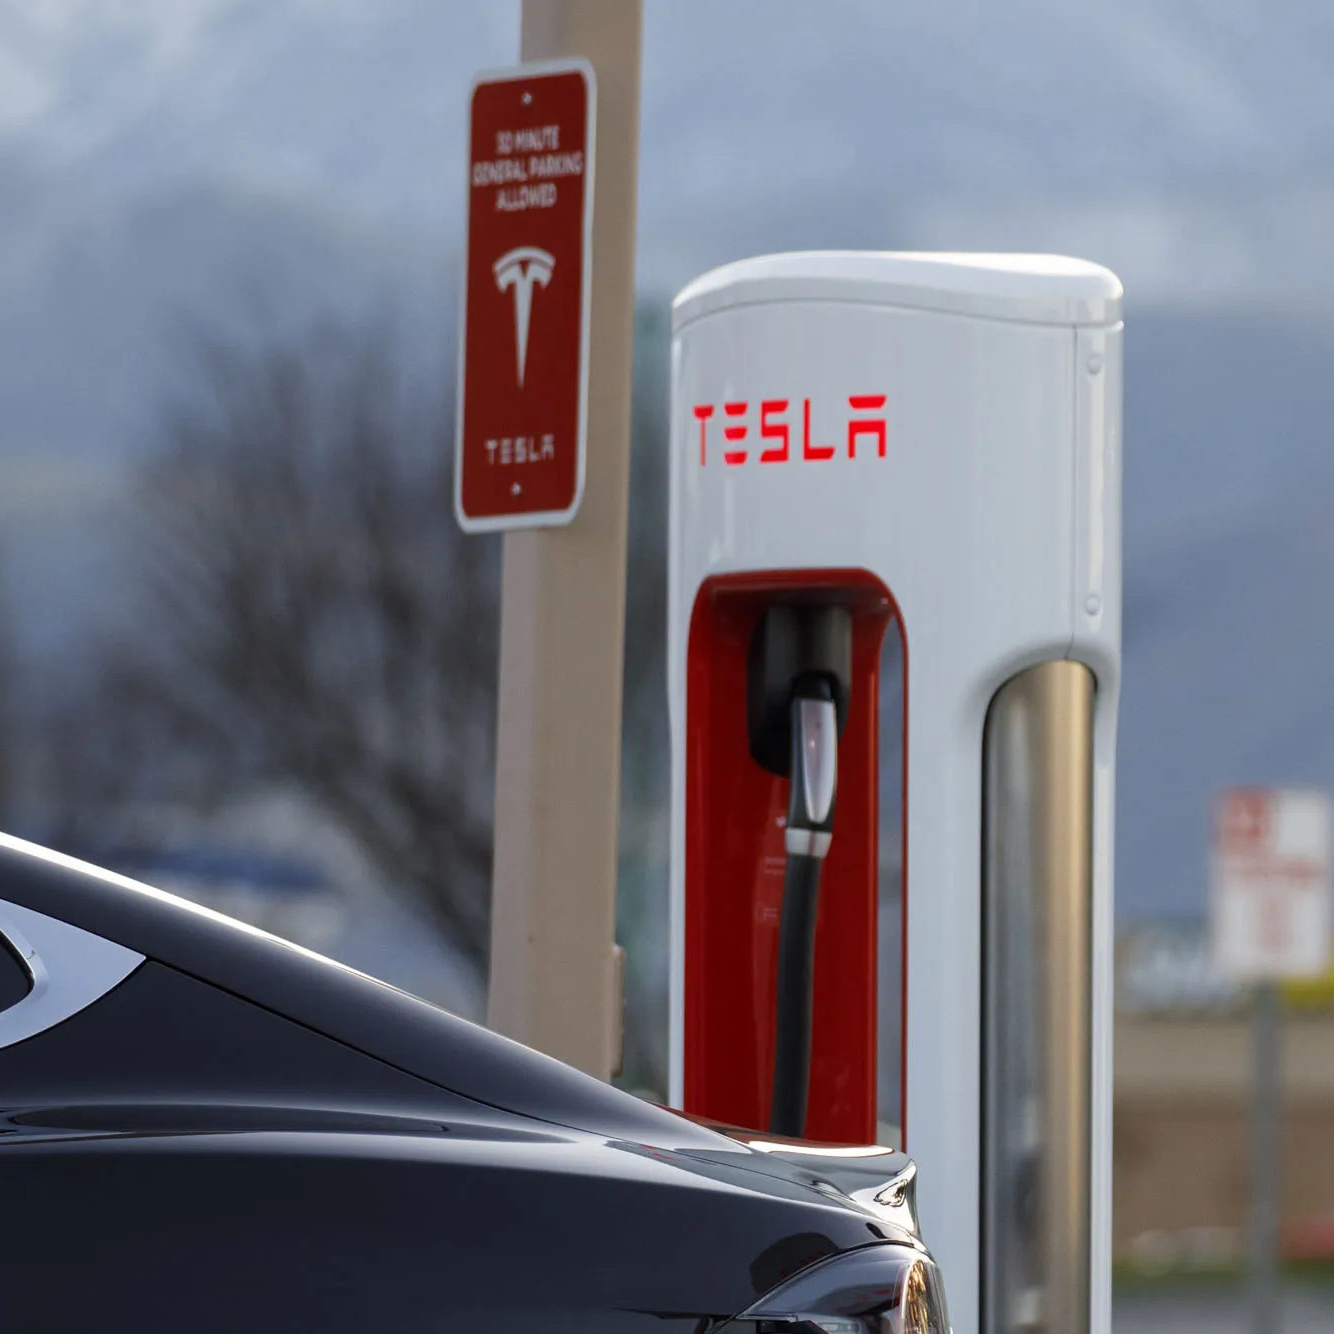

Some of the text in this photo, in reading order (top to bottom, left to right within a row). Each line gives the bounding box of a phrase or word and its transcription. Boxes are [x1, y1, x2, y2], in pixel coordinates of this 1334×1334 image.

[514, 126, 559, 150] MINUTE
[473, 152, 582, 185] GENERAL PARKING
[497, 184, 556, 210] ALLOWED
[692, 394, 887, 467] TESLA
[485, 433, 554, 465] TESLA
